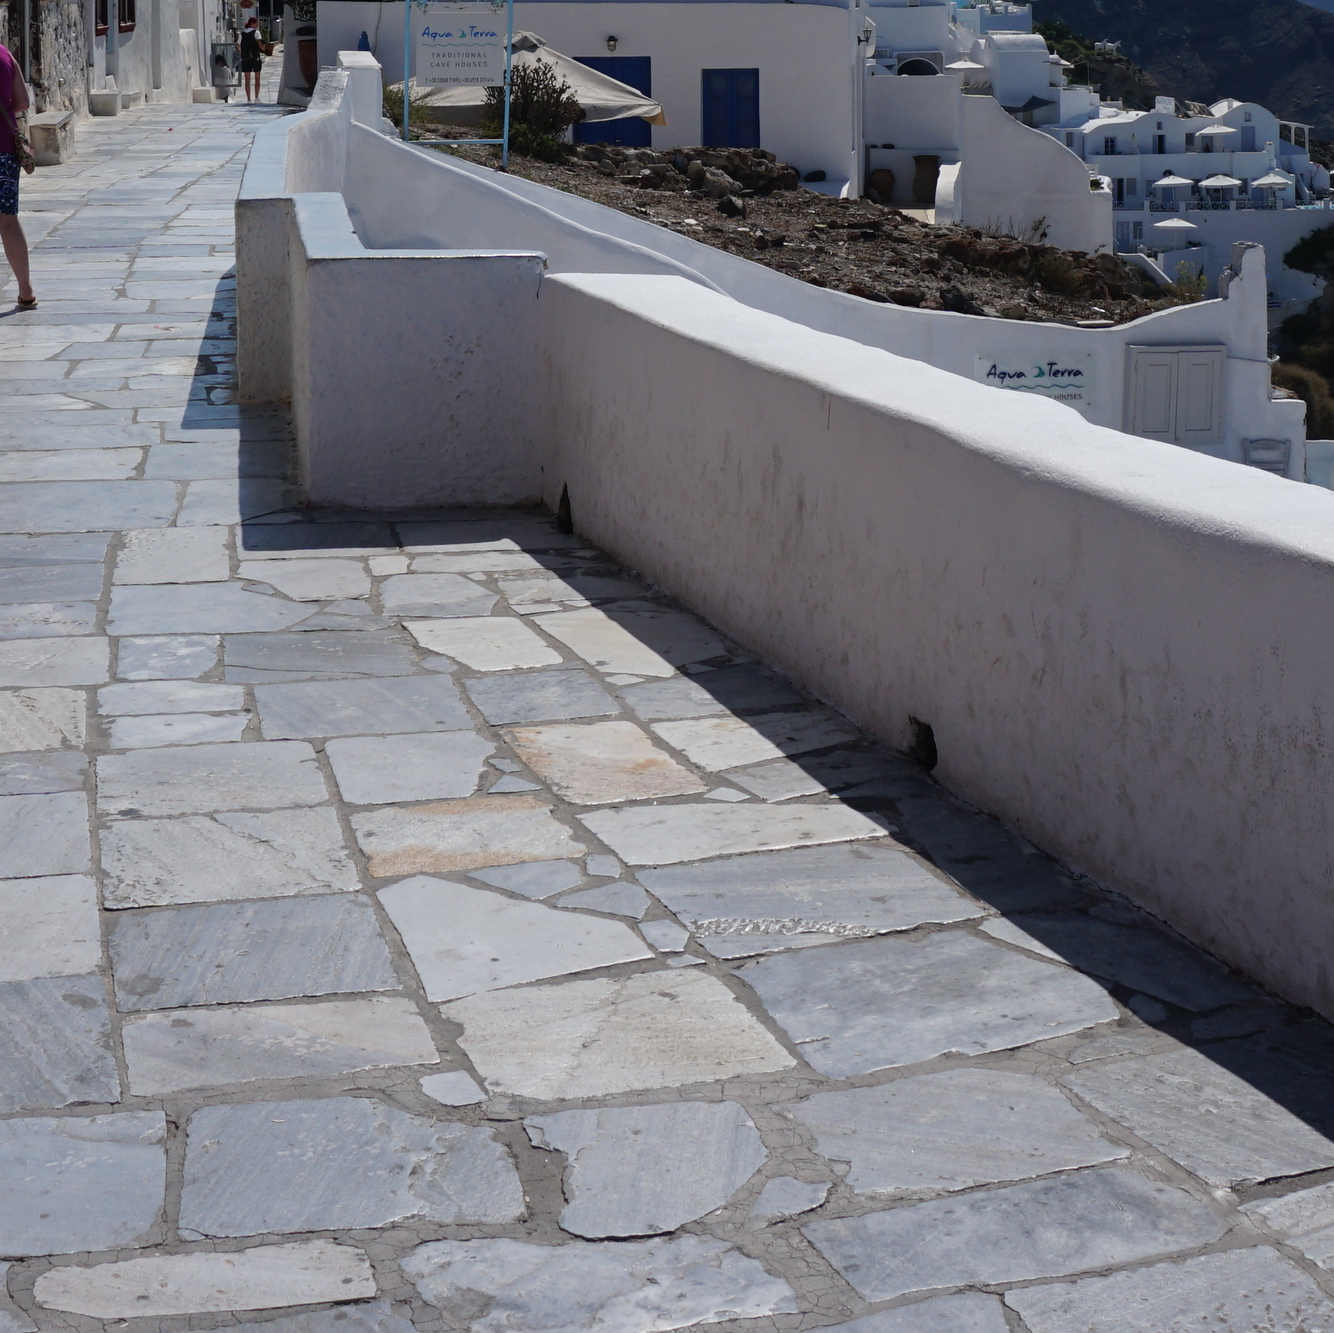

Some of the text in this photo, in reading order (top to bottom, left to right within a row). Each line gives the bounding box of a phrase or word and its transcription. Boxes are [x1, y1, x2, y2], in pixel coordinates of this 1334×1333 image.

[421, 25, 498, 42] Aqua Terra
[986, 362, 1084, 385] Aqua Terra
[1054, 393, 1083, 401] HOUSES
